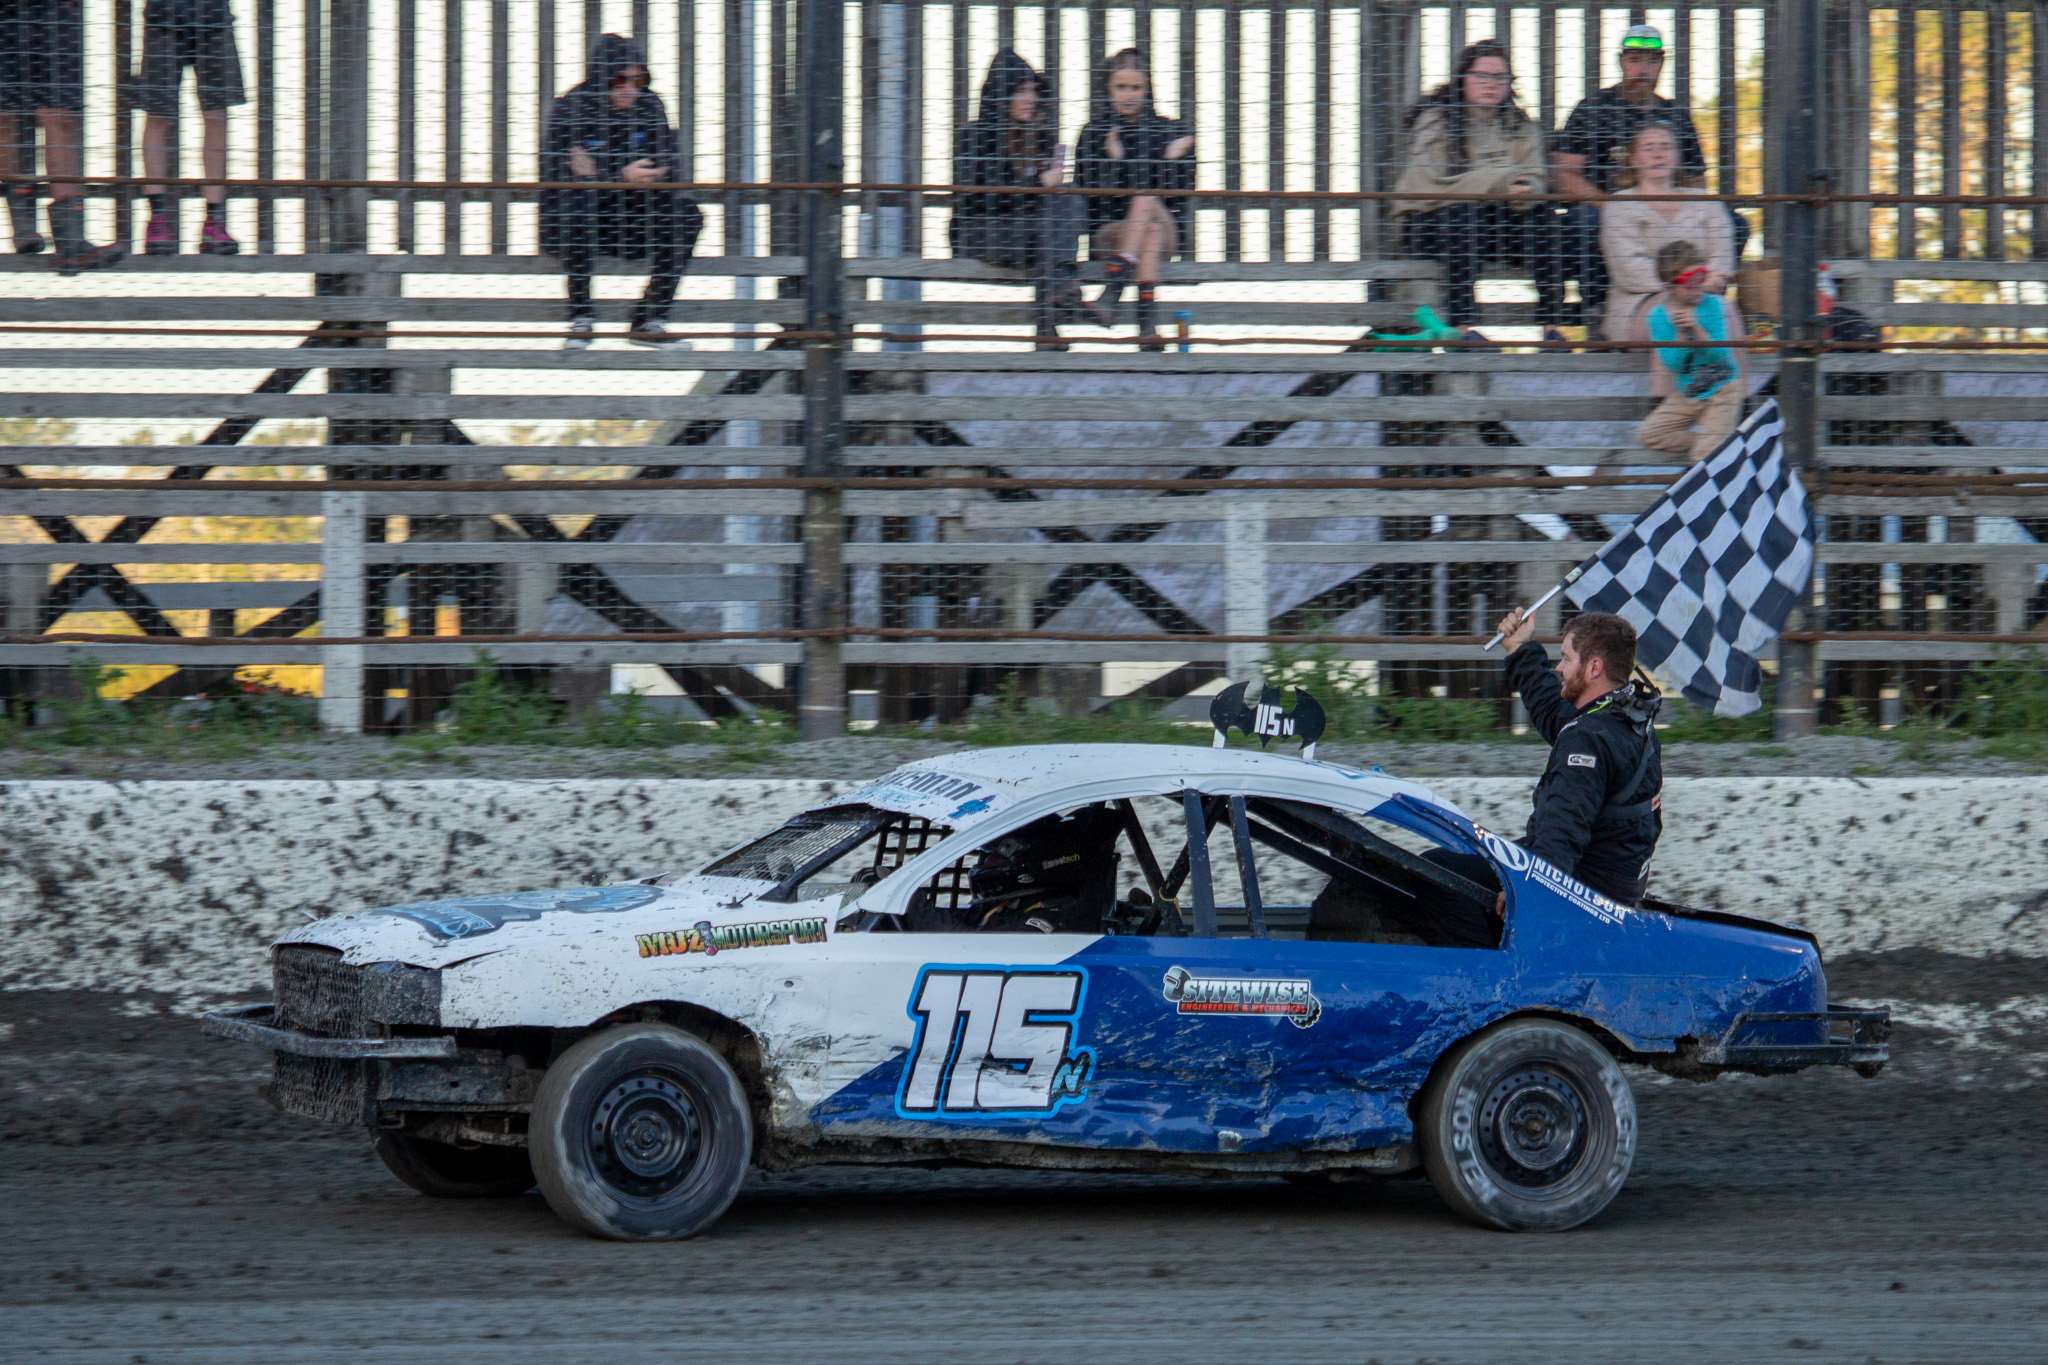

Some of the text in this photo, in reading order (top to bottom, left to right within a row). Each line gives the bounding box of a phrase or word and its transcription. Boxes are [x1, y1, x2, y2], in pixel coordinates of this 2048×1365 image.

[1531, 873, 1611, 924] PROTECTIVE COATINGS LTD
[1534, 857, 1626, 921] NICHOLSON
[712, 917, 827, 950] MOTORSPORT
[1181, 1003, 1239, 1012] ENGINEERING
[1251, 1003, 1306, 1013] MECHANICAL
[1182, 980, 1309, 1004] SITEWISE
